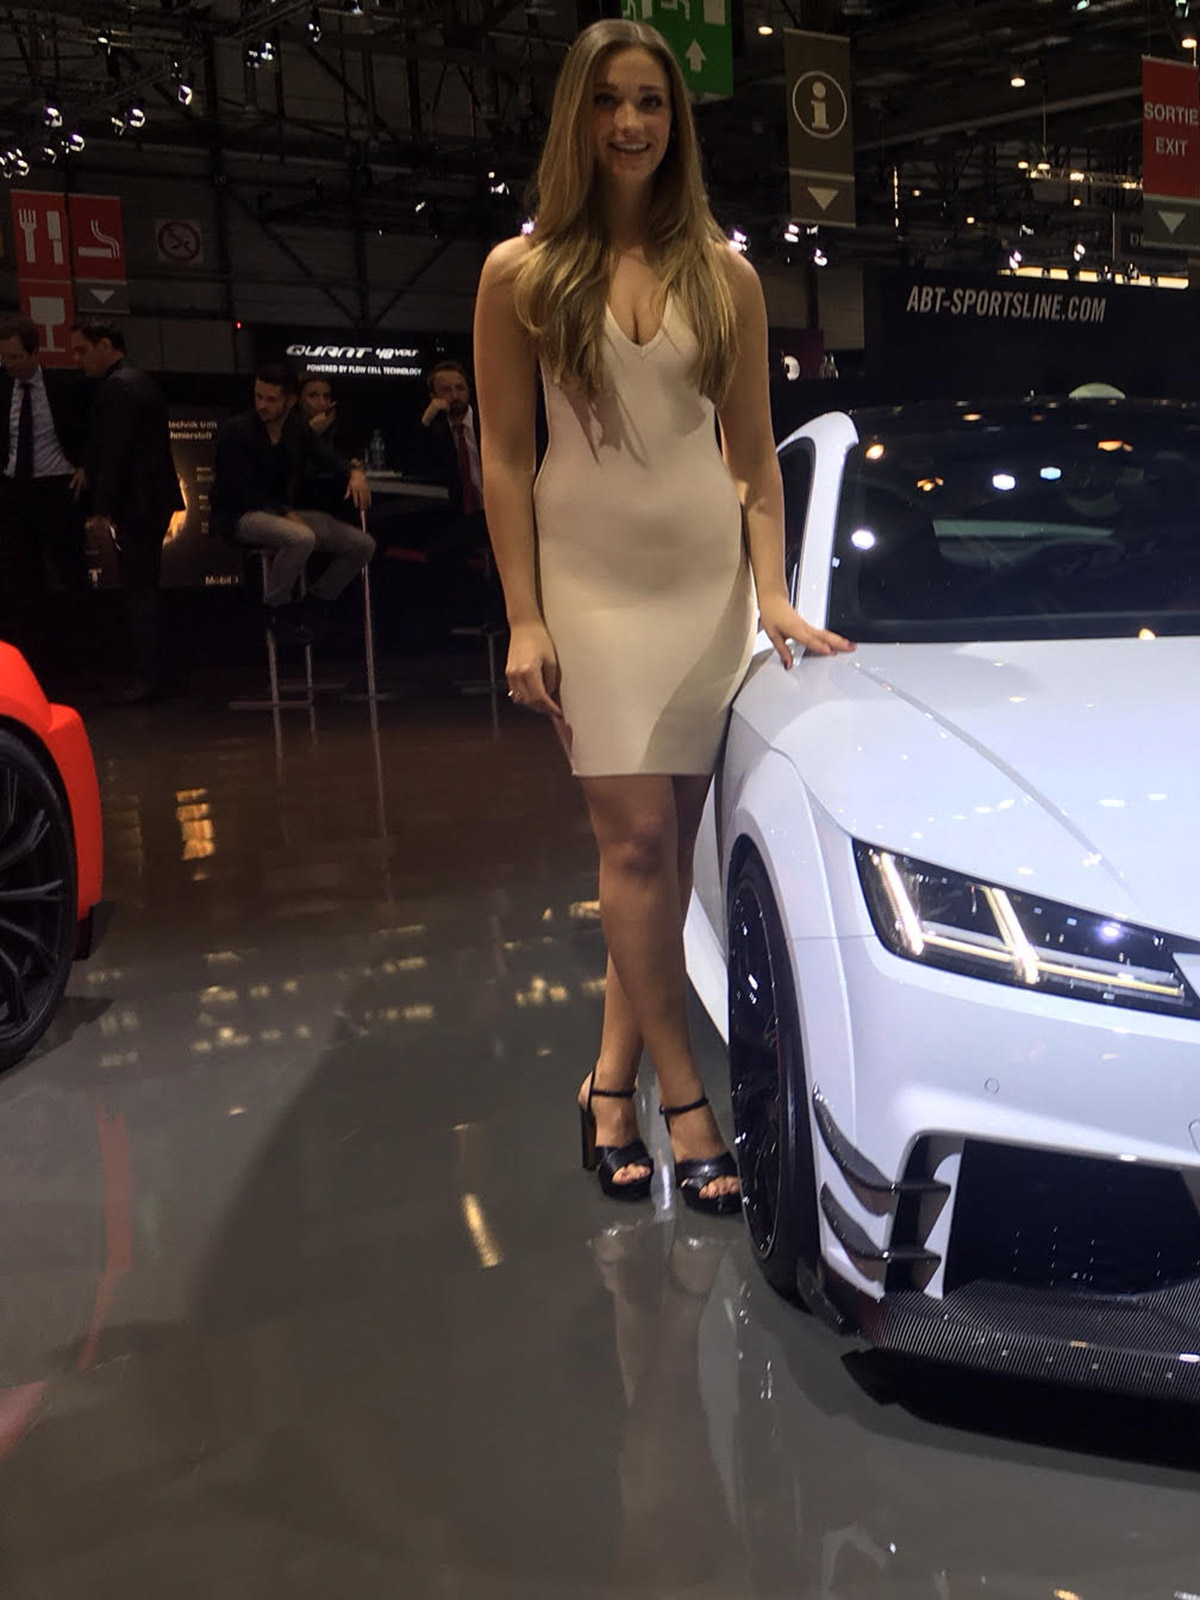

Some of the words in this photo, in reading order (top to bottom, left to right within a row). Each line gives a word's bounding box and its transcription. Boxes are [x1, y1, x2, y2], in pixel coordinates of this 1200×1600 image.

[1144, 102, 1199, 126] SORTIE
[1155, 136, 1188, 157] EXIT
[906, 285, 1107, 323] ABT-SPORTSLINE.COM
[306, 364, 338, 373] POWERED
[339, 365, 347, 374] BY
[349, 365, 366, 374] FLOW
[367, 366, 381, 375] CELL
[383, 366, 422, 376] TECHNOLOGY
[205, 575, 232, 586] Mobil
